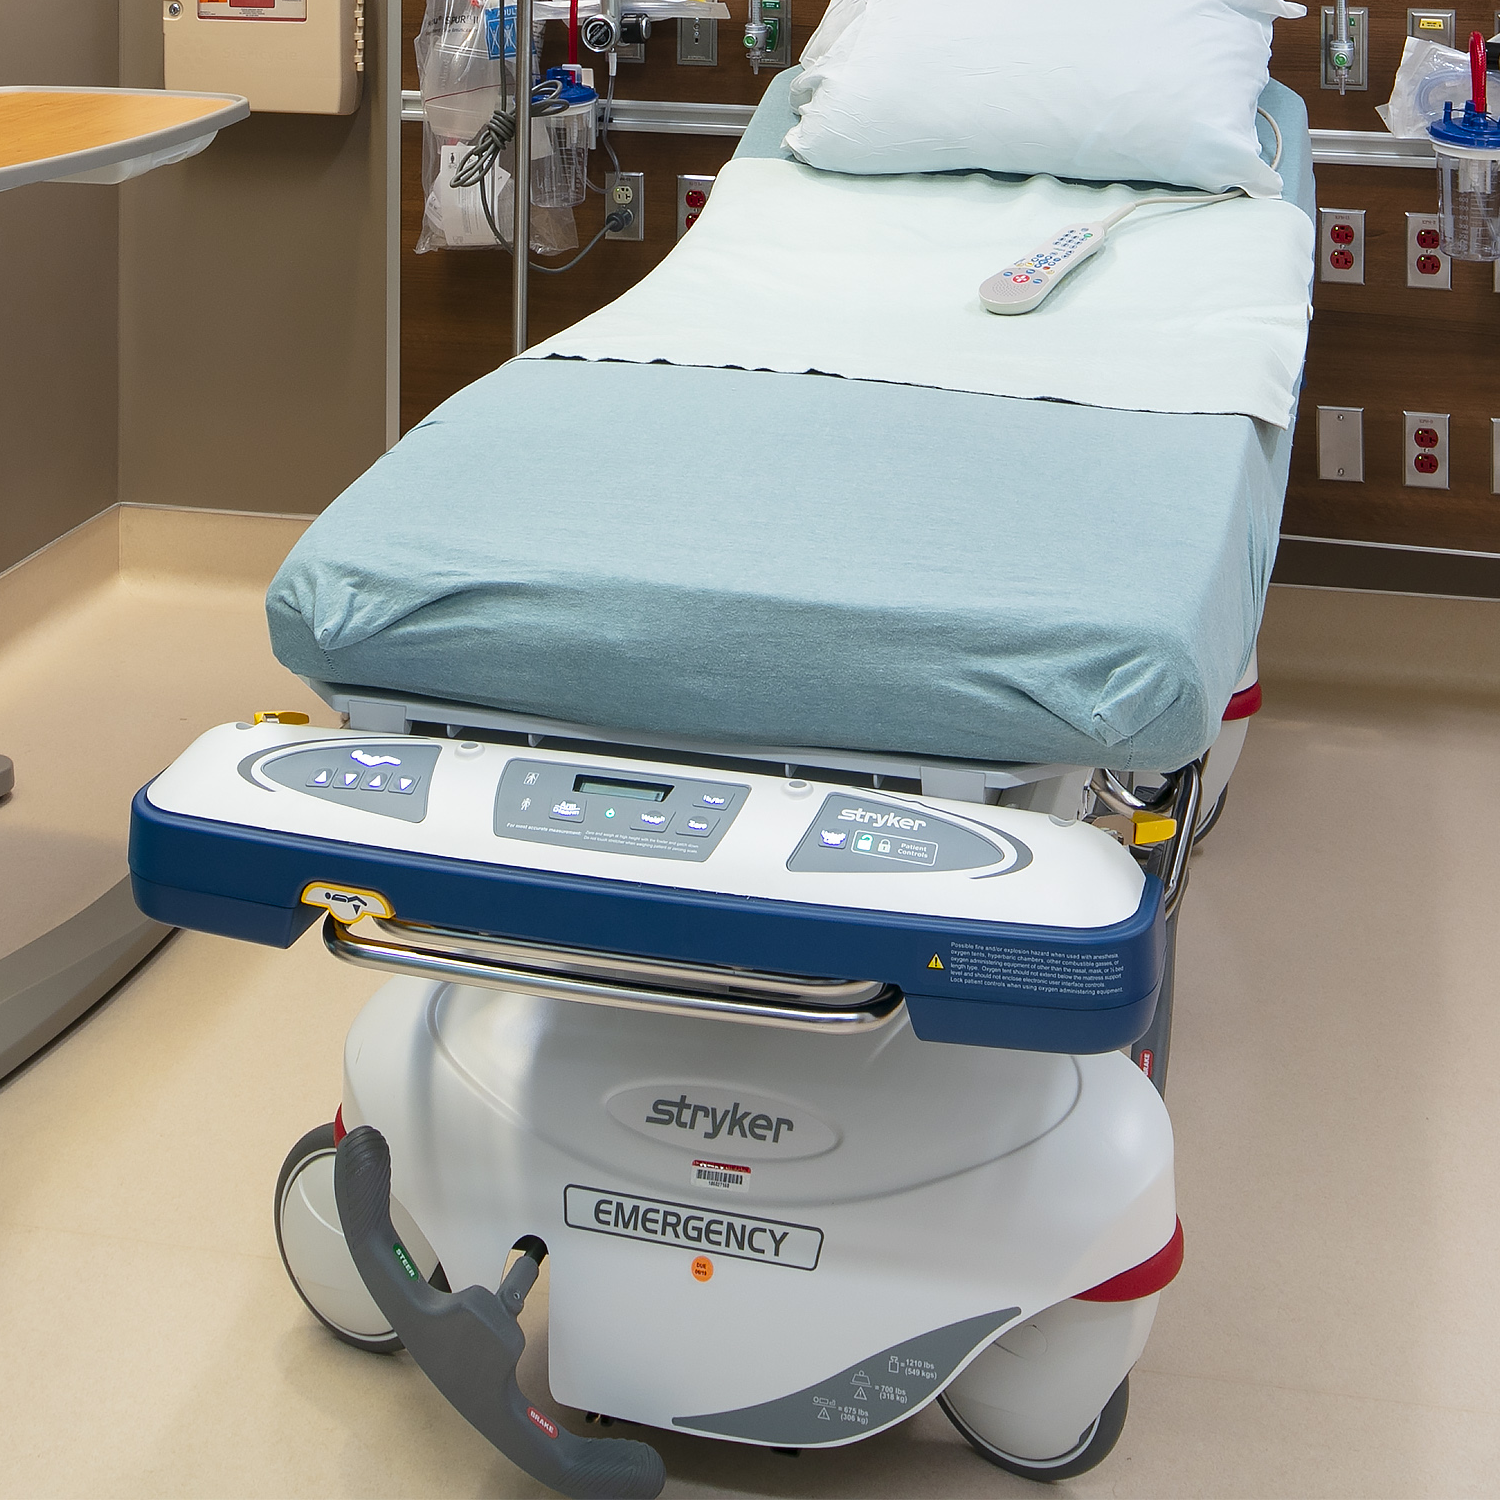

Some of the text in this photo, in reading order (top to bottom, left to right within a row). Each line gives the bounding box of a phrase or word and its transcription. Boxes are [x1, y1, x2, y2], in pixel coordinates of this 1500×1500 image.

[838, 808, 926, 831] stryker
[901, 842, 927, 852] Patient
[898, 849, 928, 858] Controls
[970, 958, 1002, 966] administering
[646, 1095, 794, 1144] stryker
[594, 1199, 789, 1257] EMERGENCY
[396, 1248, 415, 1277] STEER
[906, 1359, 934, 1370] 1210 lbs
[905, 1368, 937, 1380] (549 kgs)
[881, 1385, 894, 1393] 700
[880, 1391, 907, 1404] (318 kg)
[844, 1406, 868, 1416] 675 lbs
[530, 1410, 554, 1433] BRAKE
[841, 1412, 868, 1425] (306 kg)
